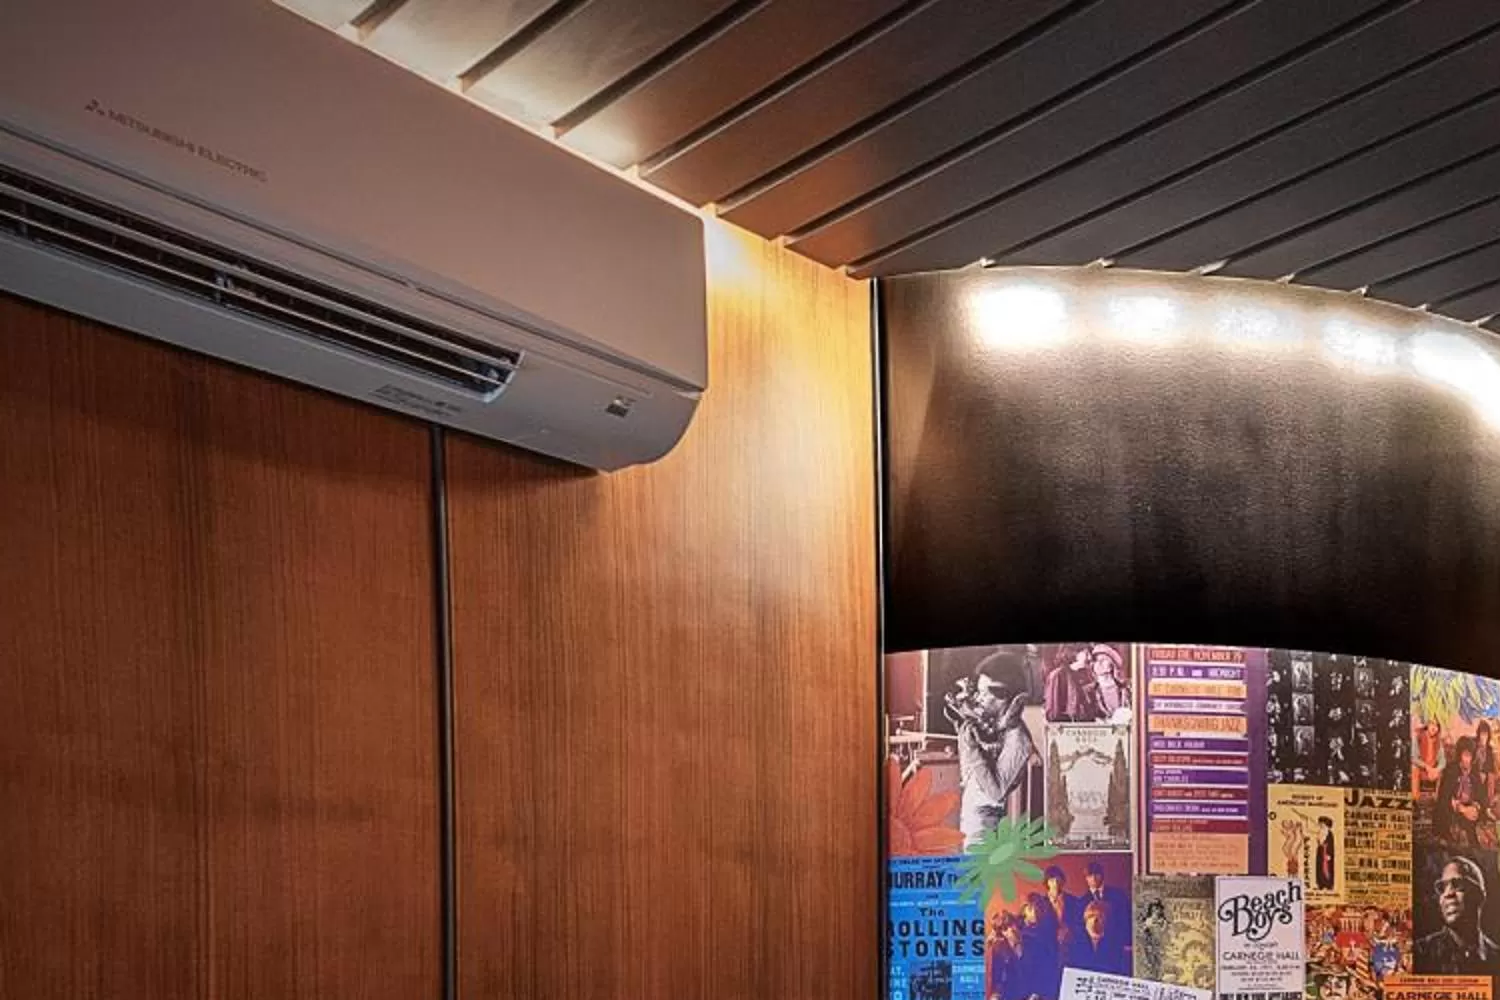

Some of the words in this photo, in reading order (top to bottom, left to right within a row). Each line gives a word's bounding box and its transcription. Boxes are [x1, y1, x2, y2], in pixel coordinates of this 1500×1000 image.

[108, 108, 195, 153] MITSUBISHI
[197, 145, 268, 182] ELECTRIC
[1344, 789, 1412, 810] JAZZ
[888, 871, 945, 888] URRAY
[1218, 881, 1302, 922] Beach
